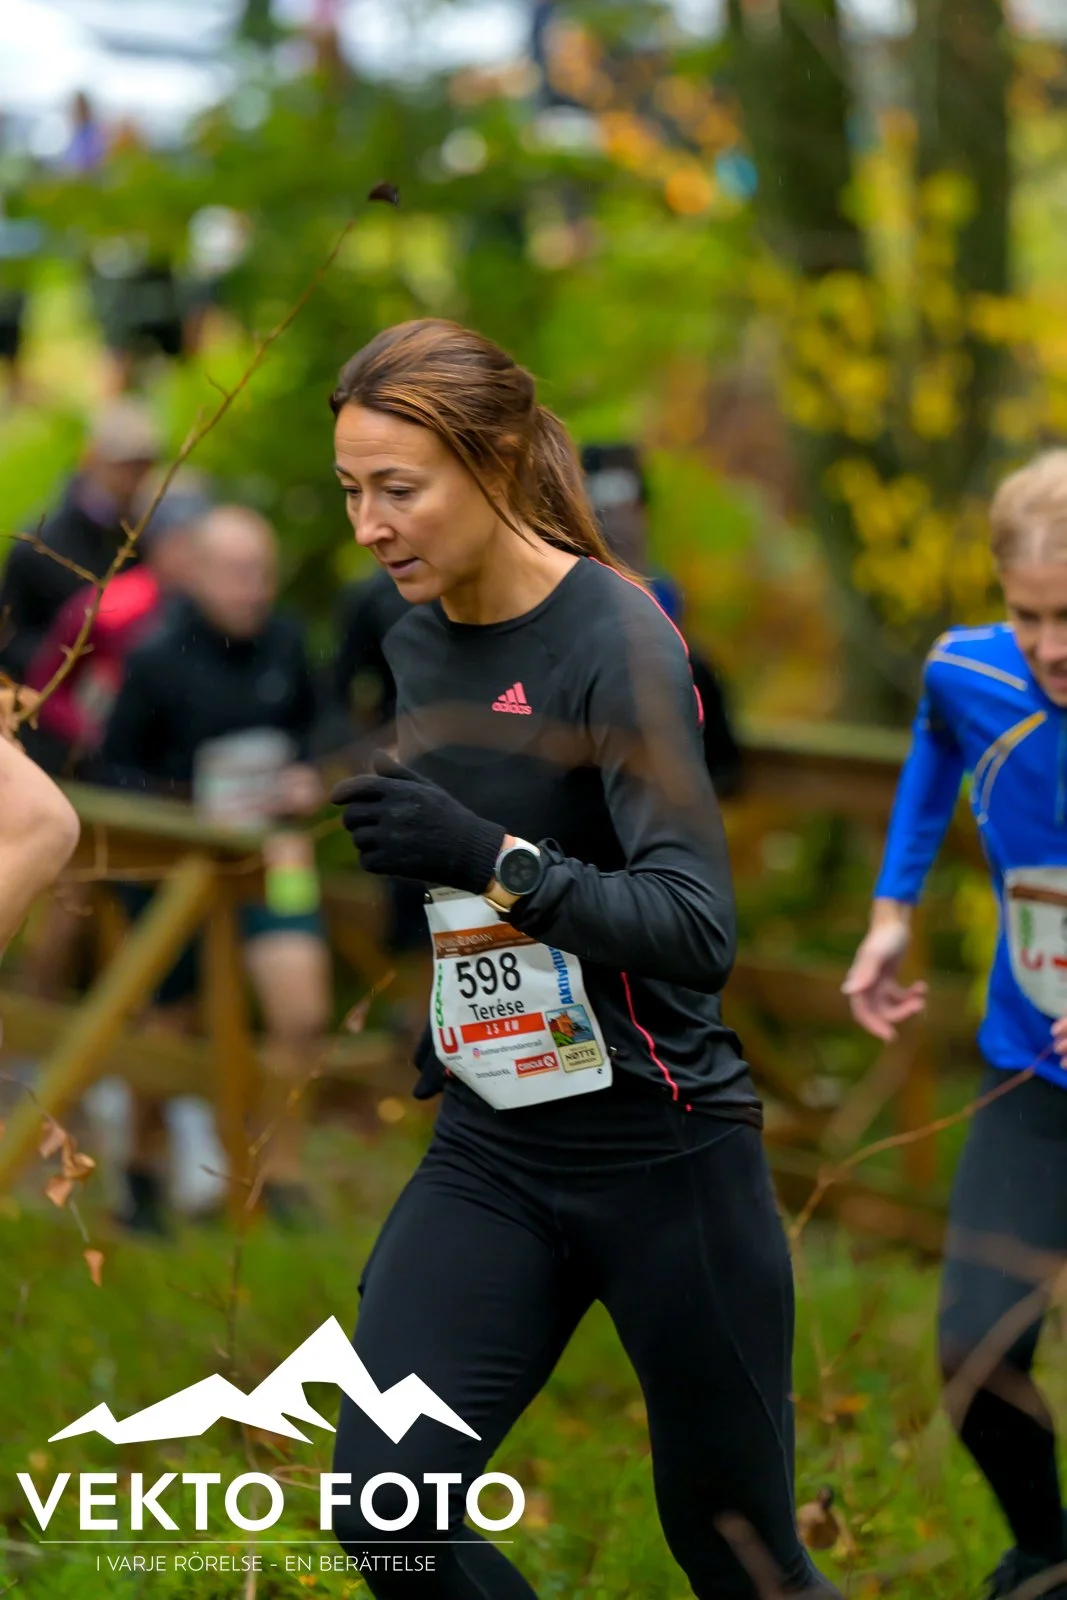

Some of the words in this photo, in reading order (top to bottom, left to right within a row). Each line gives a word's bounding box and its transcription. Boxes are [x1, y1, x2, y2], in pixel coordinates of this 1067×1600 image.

[491, 702, 532, 715] adidas
[455, 951, 522, 999] 598
[468, 998, 525, 1021] Terése
